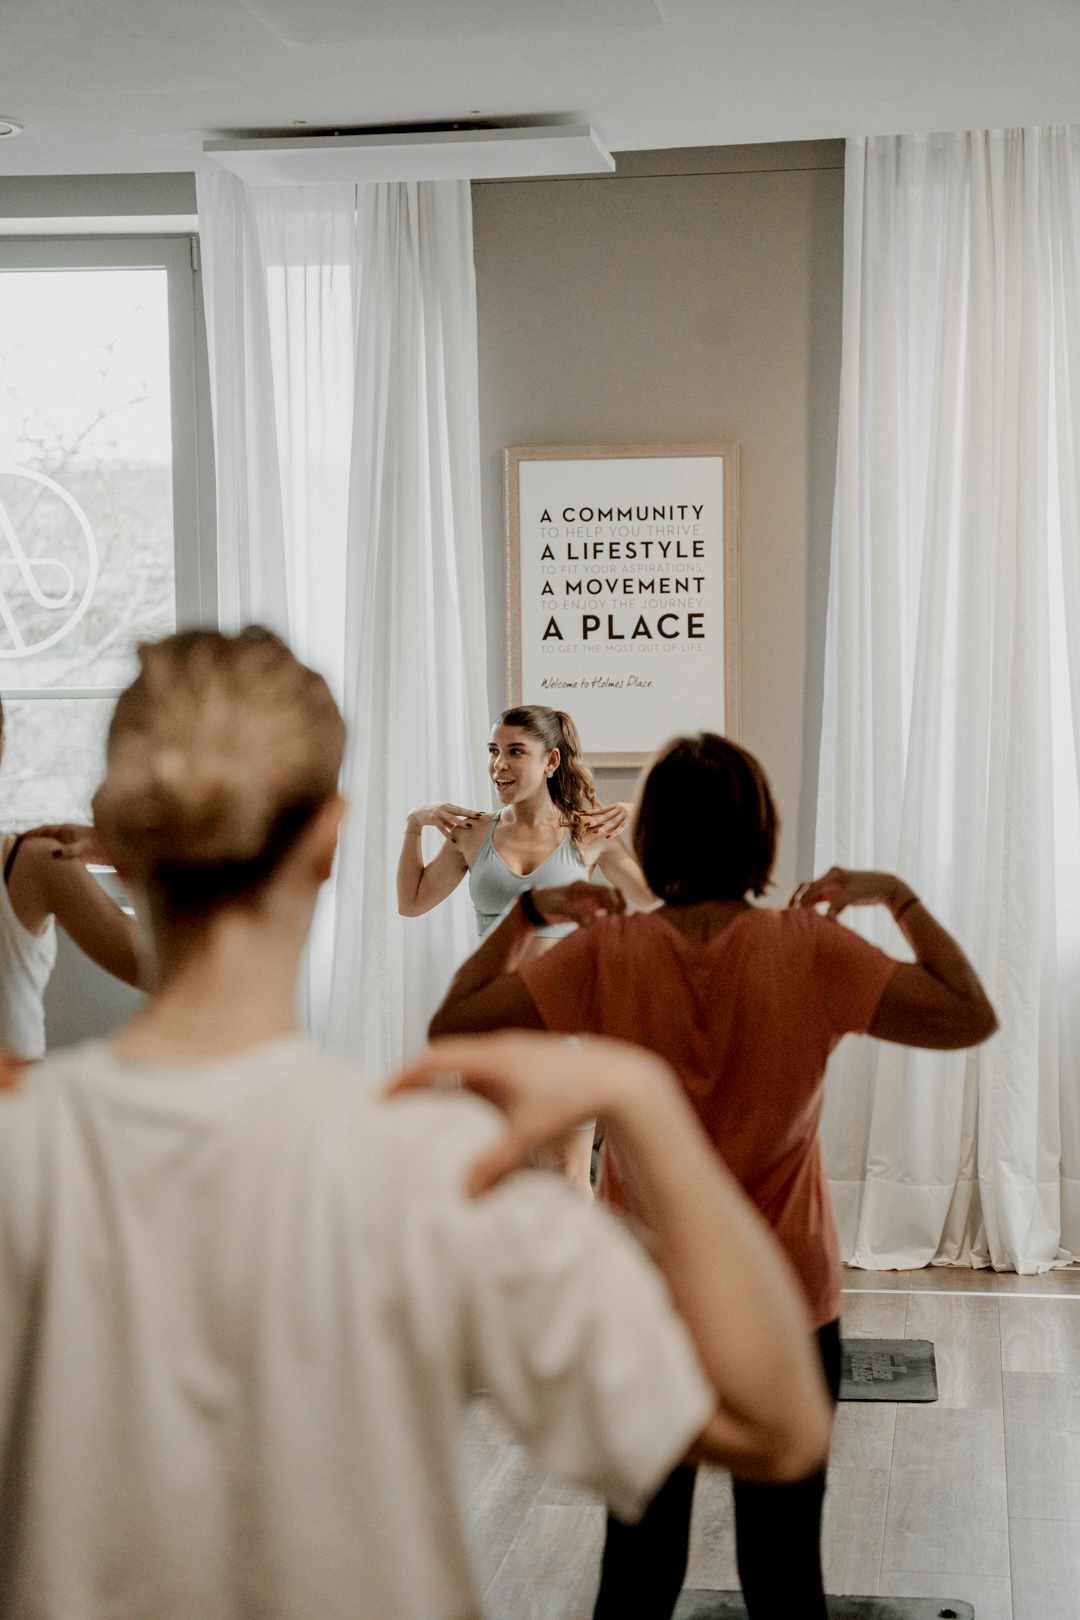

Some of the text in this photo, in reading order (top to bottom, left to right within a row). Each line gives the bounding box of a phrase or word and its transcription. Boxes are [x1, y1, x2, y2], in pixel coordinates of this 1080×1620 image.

[540, 505, 704, 522] A COMMUNITY
[540, 524, 705, 538] TO HELP YOU THRIVE.
[540, 540, 705, 560] A LIFESTYLE
[540, 563, 705, 575] TO FIT YOUR ASPIRATIONS.
[541, 577, 705, 595] A MOVEMENT
[541, 598, 706, 610] TO ENJOY THE JOURNEY.
[542, 613, 705, 640] A PLACE
[541, 645, 555, 653] TO
[559, 645, 578, 653] GET
[583, 644, 601, 653] THE
[605, 644, 633, 653] MOST
[638, 644, 658, 652] OUT
[663, 643, 677, 652] OF
[541, 678, 578, 689] Welcome
[581, 678, 590, 688] to
[592, 676, 624, 688] Holmes
